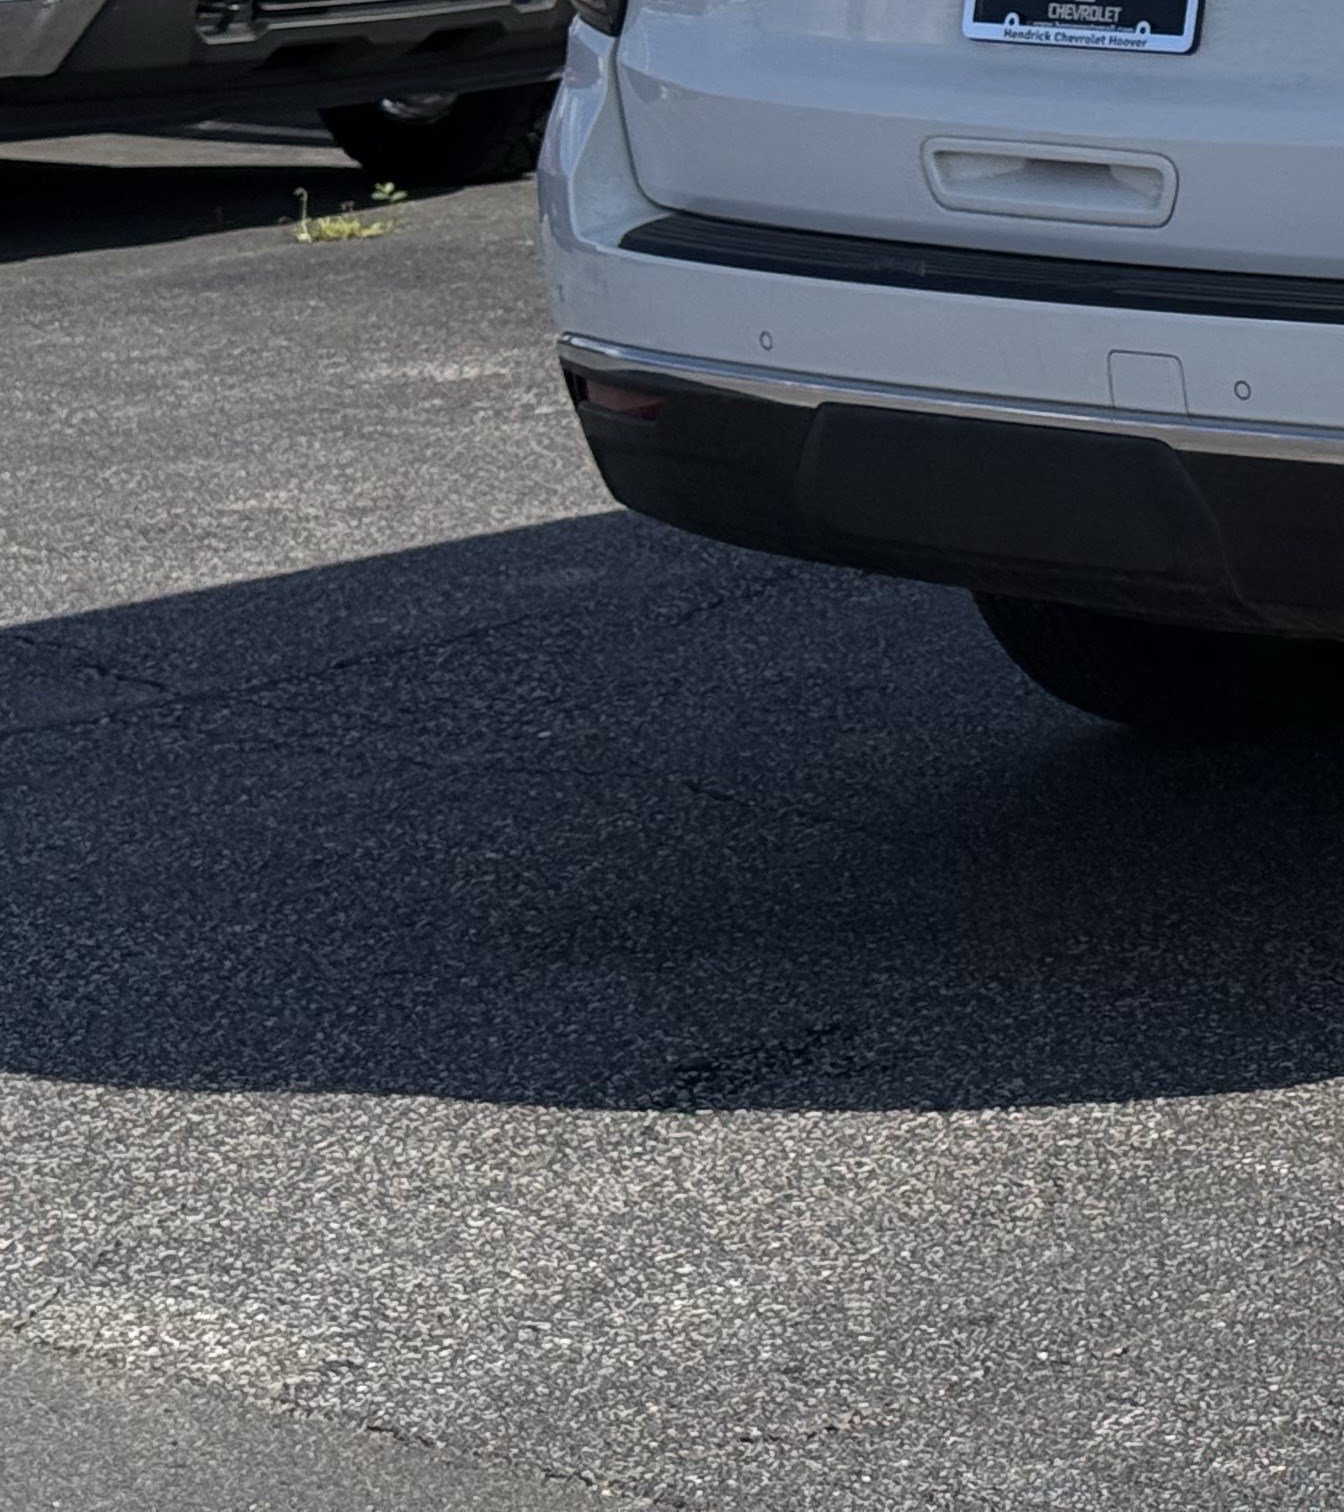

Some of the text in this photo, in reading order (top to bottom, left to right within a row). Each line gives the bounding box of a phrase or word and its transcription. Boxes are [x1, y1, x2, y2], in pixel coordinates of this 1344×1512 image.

[1048, 2, 1122, 23] CHEVROLET
[1003, 28, 1148, 48] Hendrick Chevrolet Hoover
